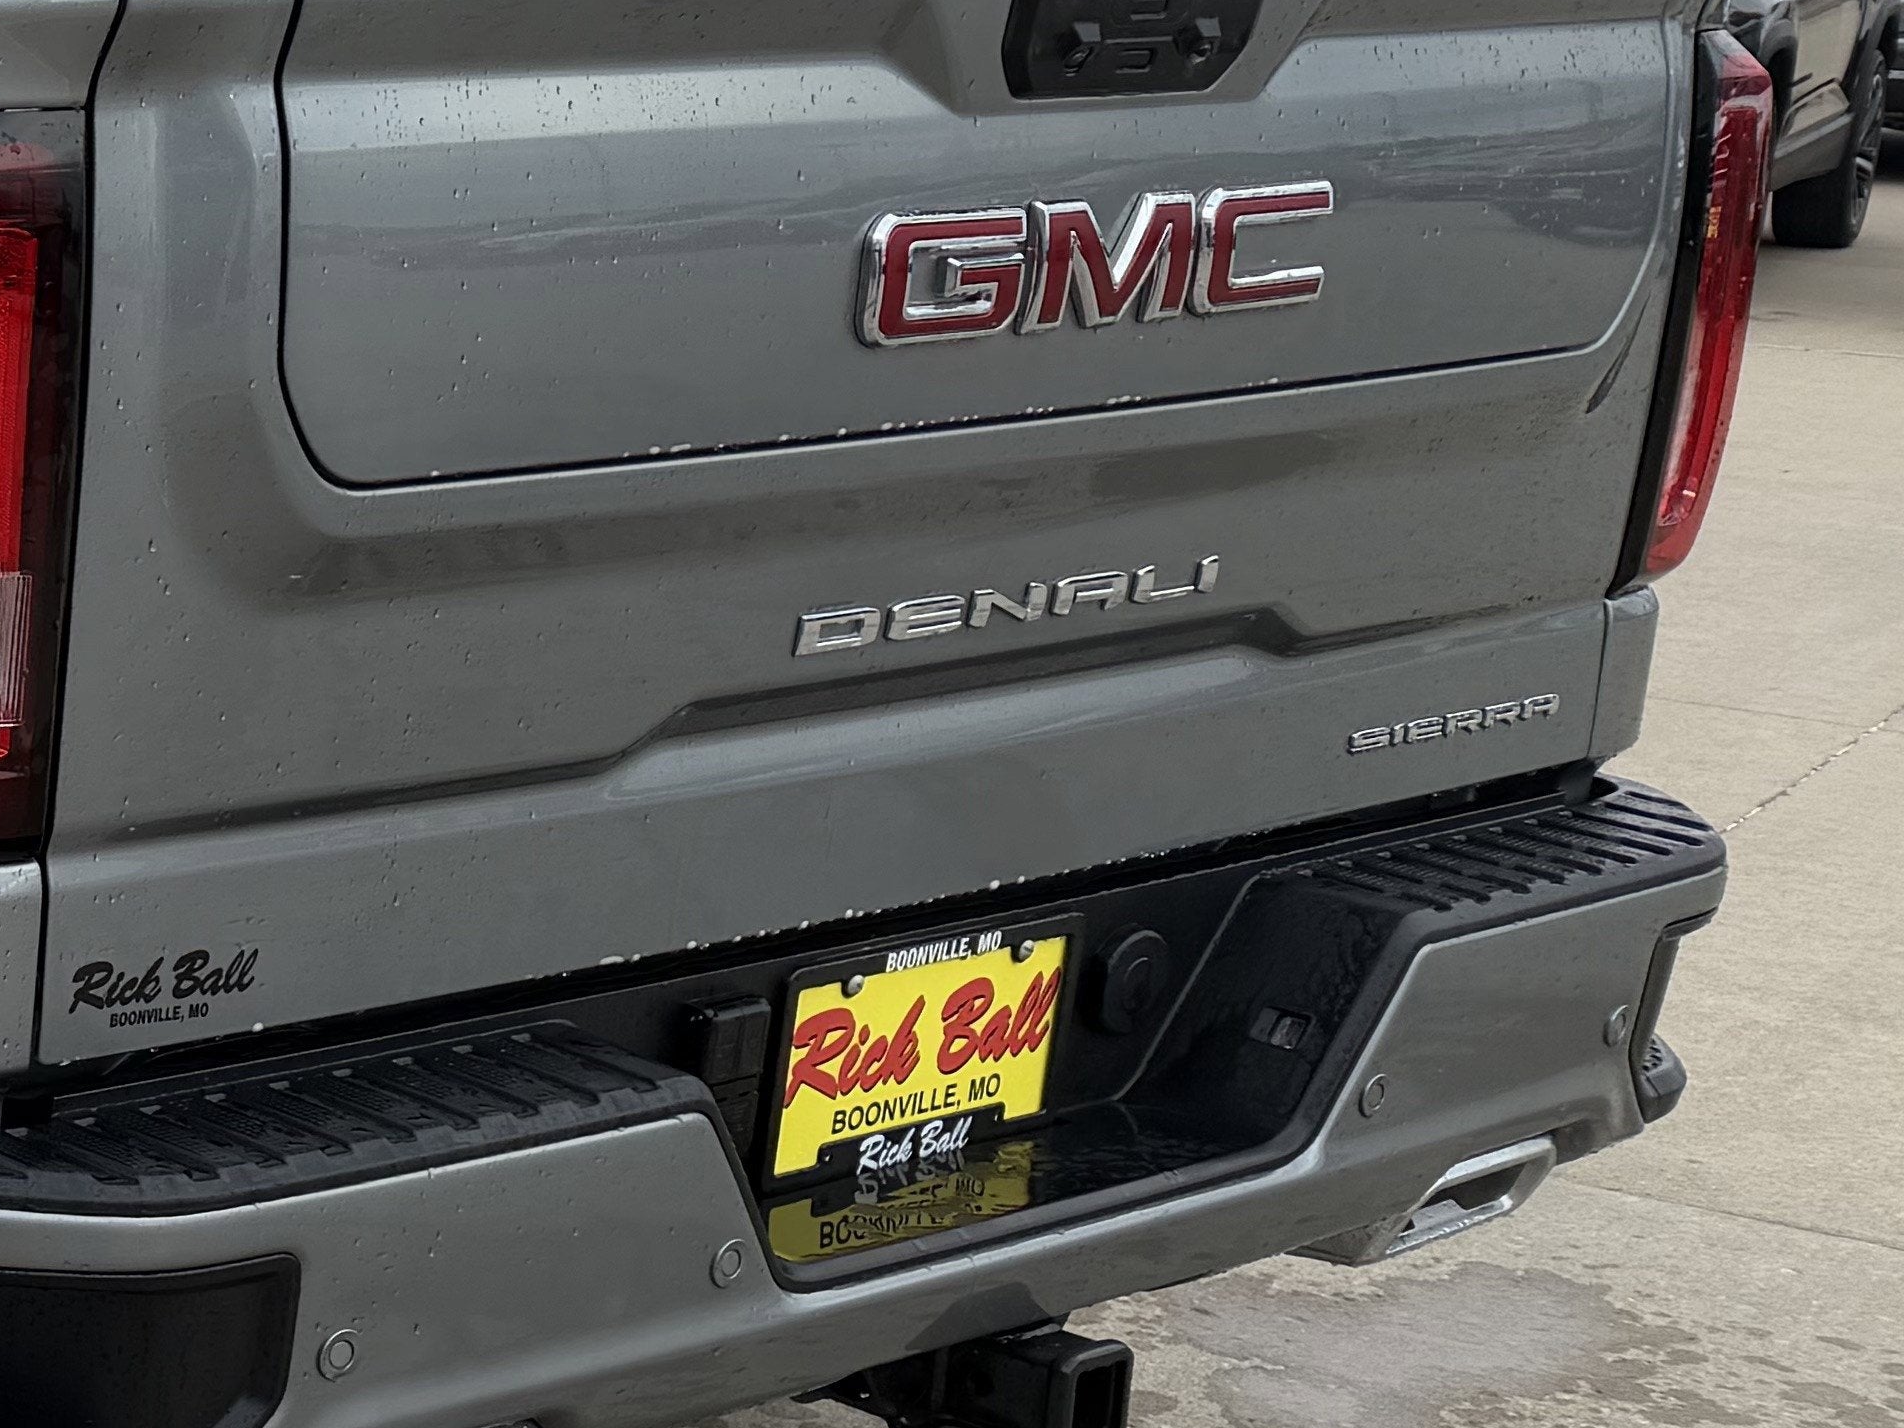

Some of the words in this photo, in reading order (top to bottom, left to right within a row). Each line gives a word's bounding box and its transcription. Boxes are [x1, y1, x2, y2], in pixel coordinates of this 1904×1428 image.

[854, 179, 1335, 349] GMC
[792, 554, 1222, 657] DENALI
[1346, 692, 1562, 756] SIERRA
[68, 956, 165, 1015] Rick
[171, 947, 259, 1000] Ball
[885, 936, 973, 973] BOONVILLE,
[977, 929, 1003, 956] MO
[109, 1004, 185, 1029] BOONVILLE,
[188, 1002, 210, 1019] MO
[783, 994, 927, 1109] Rick
[936, 966, 1062, 1076] Ball
[830, 1083, 962, 1136] BOONVILLE,
[968, 1072, 1002, 1104] MO
[856, 1127, 914, 1176] Rick
[918, 1116, 974, 1159] Ball
